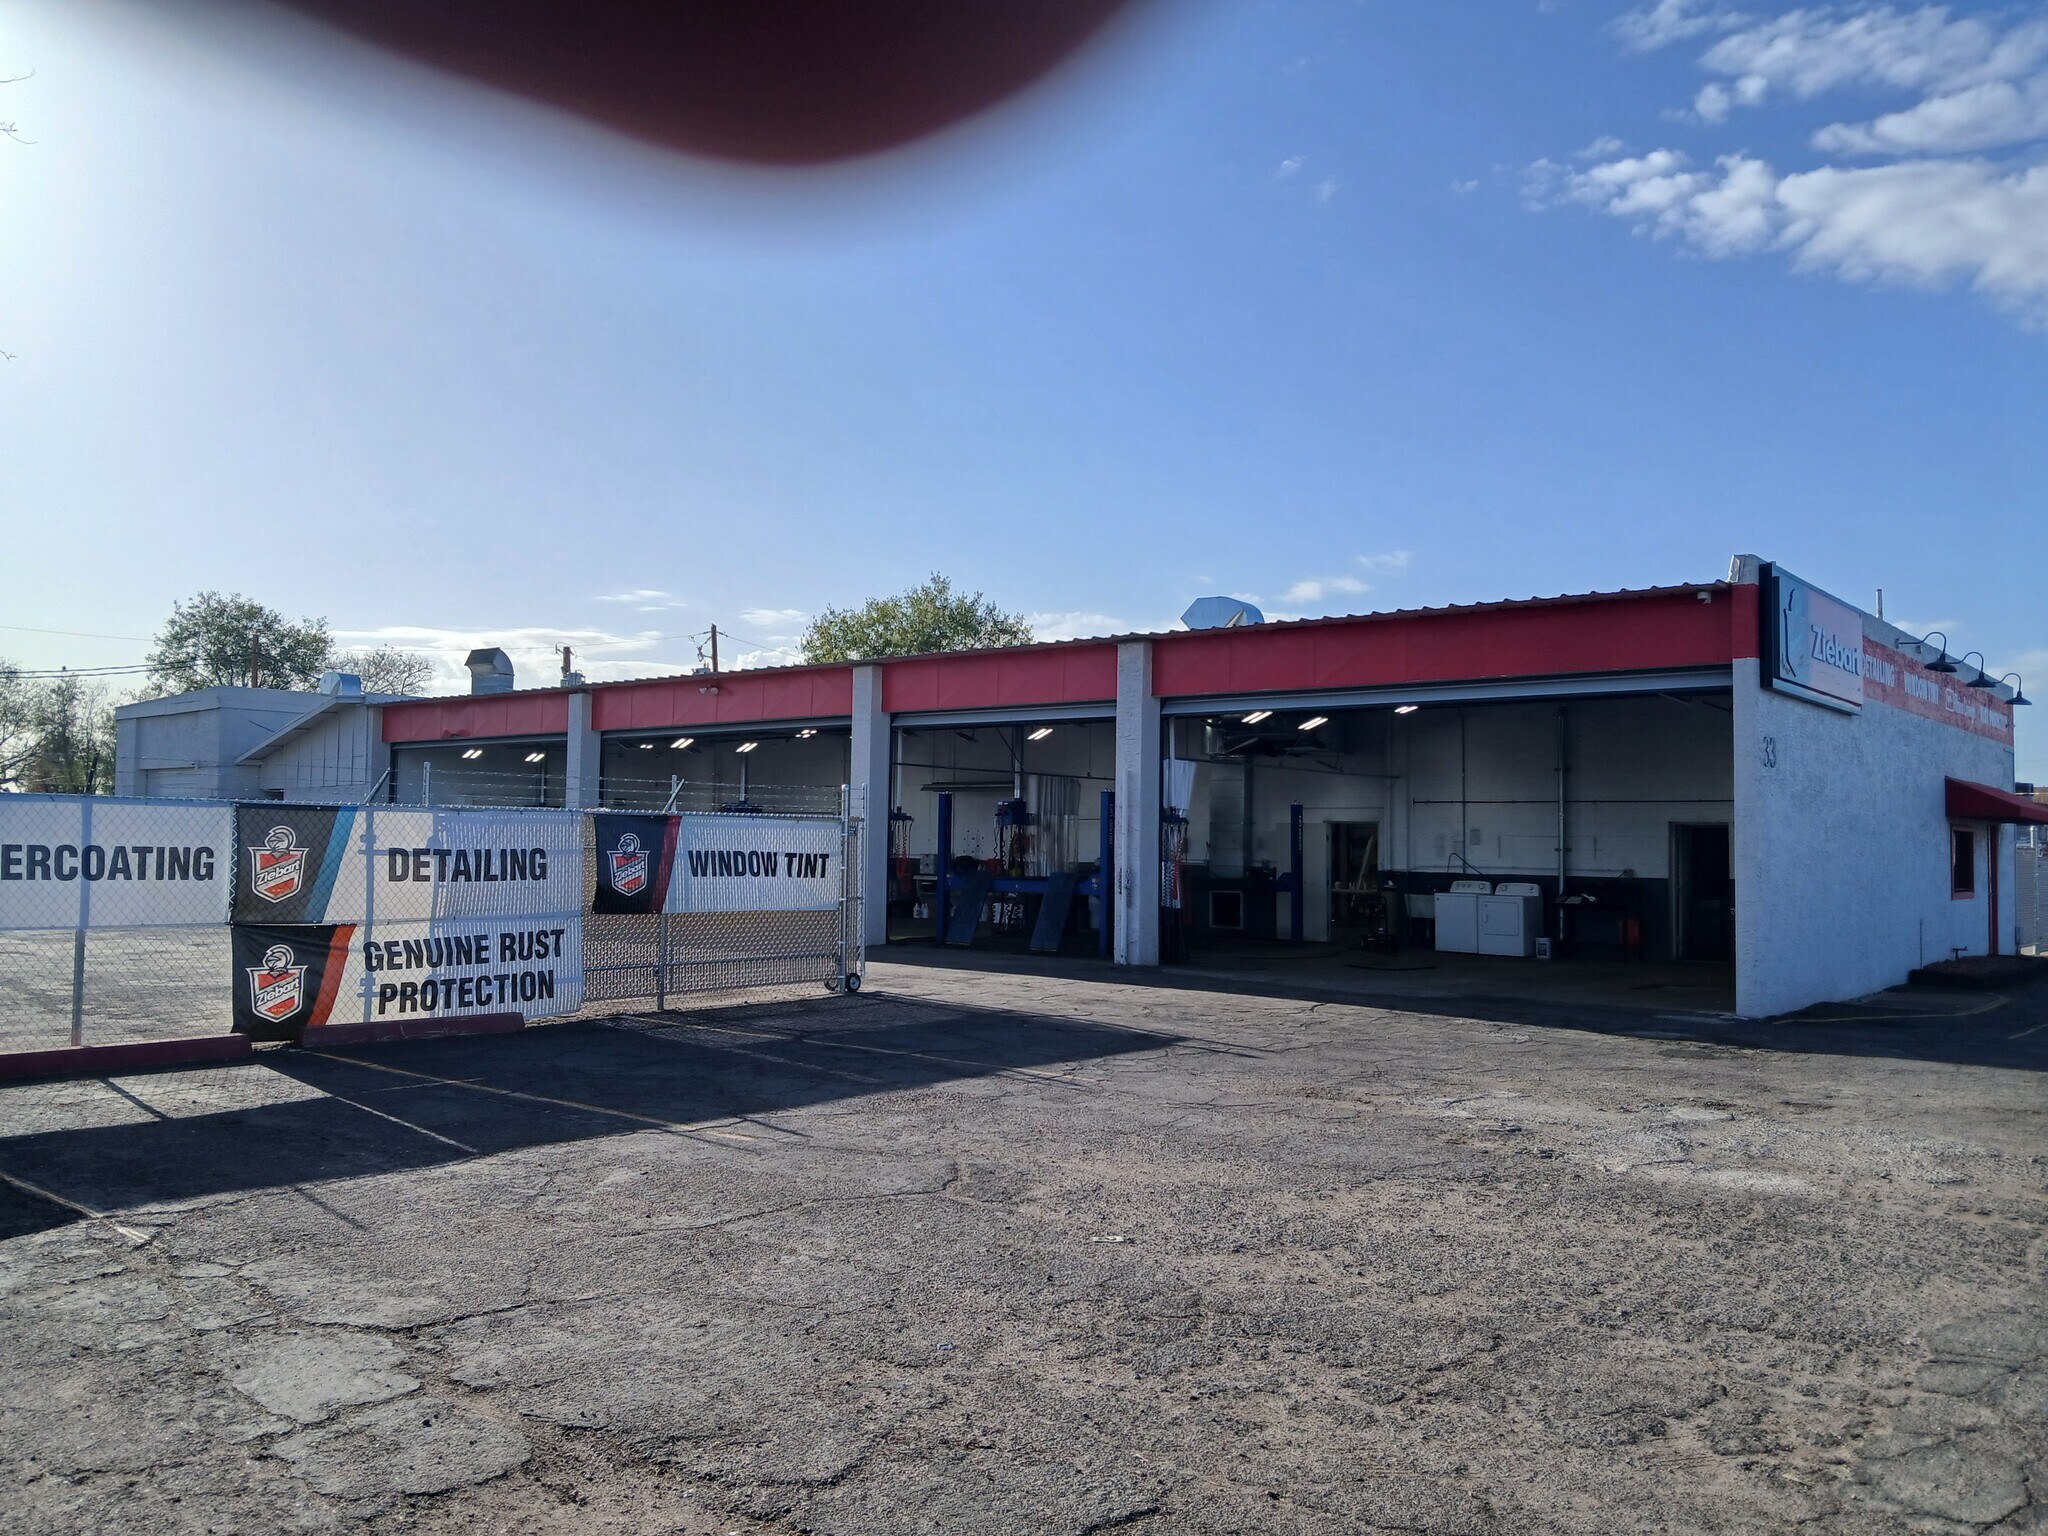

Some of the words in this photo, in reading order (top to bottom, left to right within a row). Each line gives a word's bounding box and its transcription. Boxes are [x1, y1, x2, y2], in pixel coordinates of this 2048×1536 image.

[1, 844, 215, 882] ERCOATING
[388, 848, 548, 882] DETAILING
[688, 850, 778, 878] WINDOW
[785, 853, 830, 878] TINT
[363, 935, 490, 972] GENUINE
[499, 928, 565, 963] RUST
[378, 970, 555, 1015] PROTECTION
